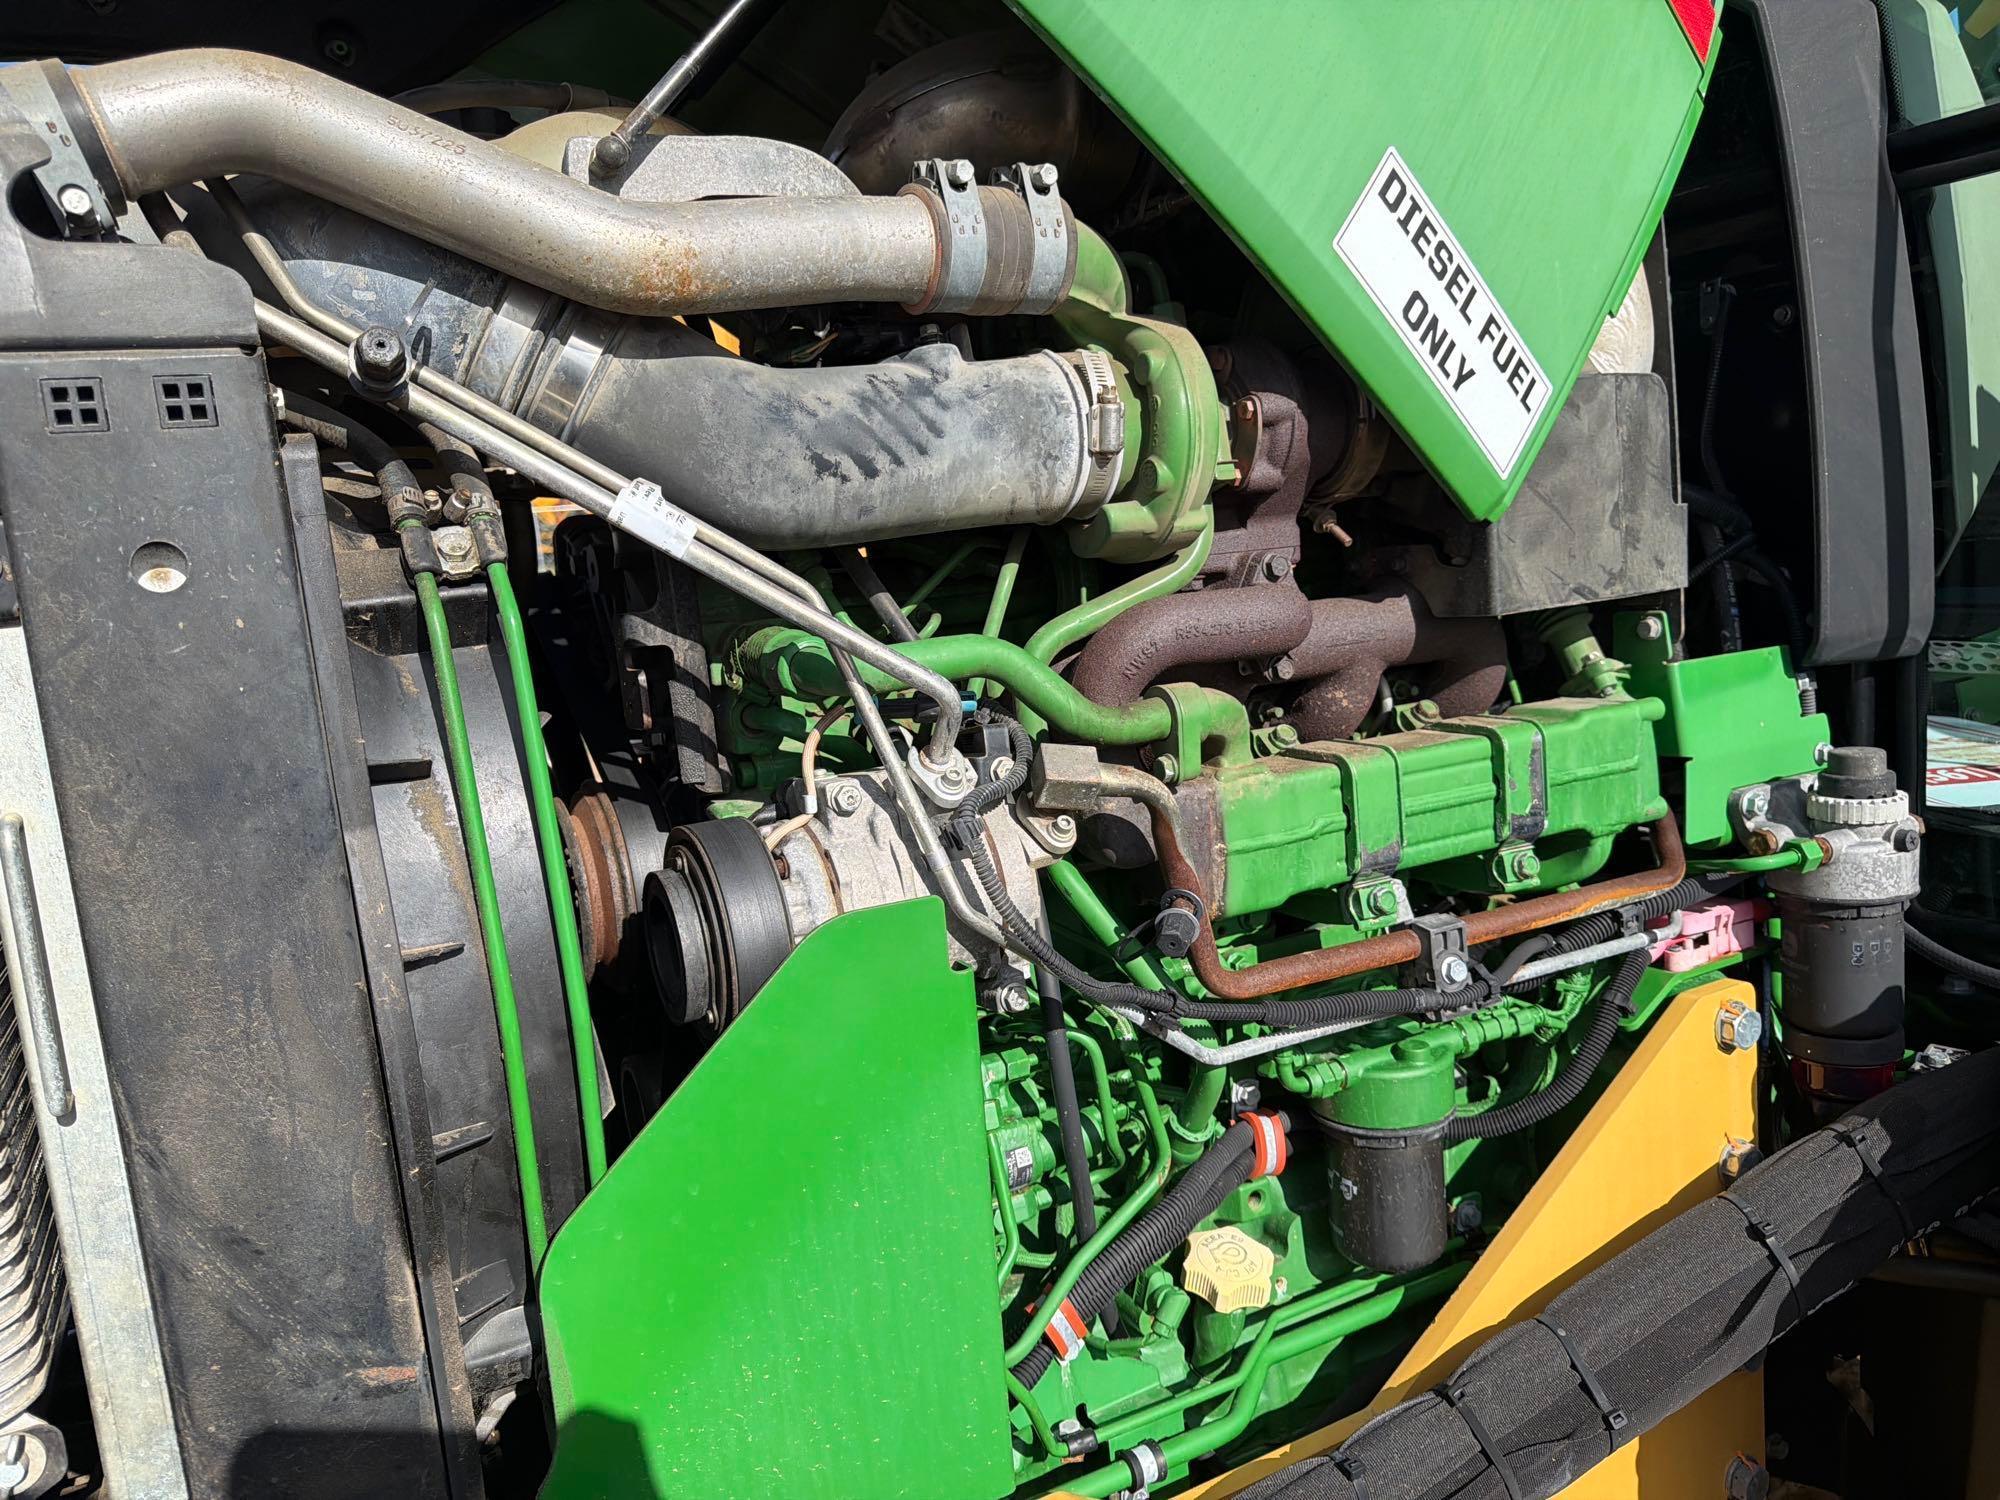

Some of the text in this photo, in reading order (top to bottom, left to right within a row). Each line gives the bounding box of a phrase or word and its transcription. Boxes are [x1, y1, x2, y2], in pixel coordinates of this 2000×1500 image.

[1378, 168, 1536, 414] DIESEL FUEL
[1403, 290, 1476, 392] ONLY
